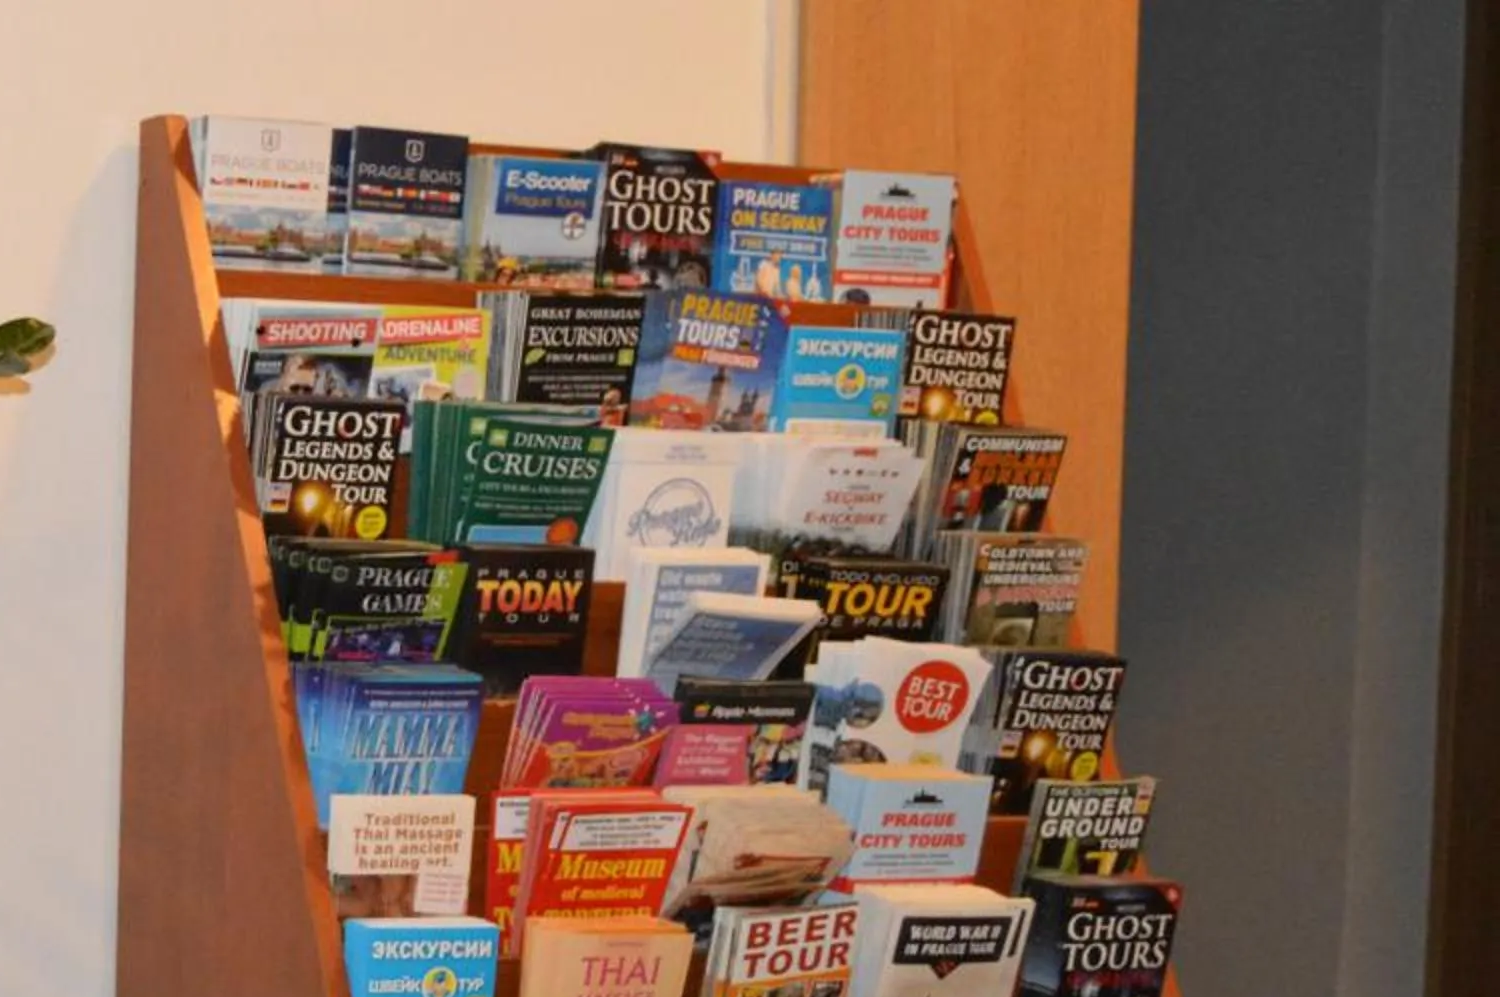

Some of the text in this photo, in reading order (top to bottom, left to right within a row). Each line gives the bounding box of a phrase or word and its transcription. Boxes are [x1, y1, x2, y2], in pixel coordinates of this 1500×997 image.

[358, 162, 462, 186] PRAGUE BOATS
[506, 169, 591, 192] E-Scooter
[610, 170, 715, 204] GHOST
[734, 188, 800, 210] PRAGUE
[606, 201, 711, 234] TOURS
[732, 210, 826, 232] ON SEGWAY
[862, 204, 930, 221] PRAGUE
[844, 225, 941, 243] CITY TOURS
[531, 307, 641, 320] GREAT BOHEMIAN
[681, 294, 759, 326] PRAGUE
[267, 321, 367, 342] SHOOTING
[528, 325, 639, 347] EXCURSIONS
[677, 318, 740, 348] TOURS
[915, 315, 1012, 348] GHOST
[384, 346, 476, 365] ADVENTURE
[796, 338, 898, 359] ЭКСКУРСИИ
[913, 346, 1006, 369] LEGENDS &
[909, 366, 1004, 389] DUNGEON
[954, 389, 999, 409] TOUR
[285, 406, 401, 439] GHOST
[282, 439, 395, 460] LEGENDS &
[513, 431, 584, 451] DINNER
[966, 437, 1064, 452] COMMUNISM
[278, 460, 391, 483] DUNGEON
[483, 451, 601, 480] CRUISES
[331, 483, 388, 504] TOUR
[1007, 485, 1050, 499] TOUR
[477, 568, 585, 579] PRAGUE
[830, 570, 870, 583] TODO
[988, 561, 1053, 572] MEDIEVAL
[356, 566, 451, 589] PRAGUE
[362, 593, 442, 614] GAMES
[476, 580, 583, 613] TODAY
[826, 581, 933, 618] TOUR
[477, 612, 580, 624] TOUR
[1023, 661, 1124, 691] GHOST
[909, 676, 961, 701] BEST
[902, 696, 952, 721] TOUR
[1018, 690, 1113, 710] LEGENDS &
[1012, 709, 1108, 731] DUNGEON
[1057, 731, 1102, 751] TOUR
[1045, 797, 1133, 817] UNDER
[364, 813, 456, 827] Traditional
[882, 812, 956, 828] PRAGUE
[1040, 816, 1144, 838] GROUND
[353, 828, 463, 842] Thai Massage
[860, 833, 966, 848] CITY TOURS
[1100, 837, 1139, 849] TOUR
[354, 842, 460, 855] is an ancient
[358, 856, 420, 871] healing
[554, 853, 667, 880] Museum
[561, 884, 646, 902] of medieval
[747, 910, 857, 949] BEER
[910, 925, 957, 940] WORLD
[960, 925, 990, 940] WAR
[1067, 912, 1173, 941] GHOST
[371, 940, 493, 959] ЭКСКУРСИИ
[903, 943, 919, 955] IN
[921, 943, 967, 955] PRAGUE
[1061, 940, 1167, 971] TOURS
[744, 943, 849, 978] TOUR
[582, 956, 663, 987] THAI
[368, 974, 485, 994] ШВЕЙК ТУР
